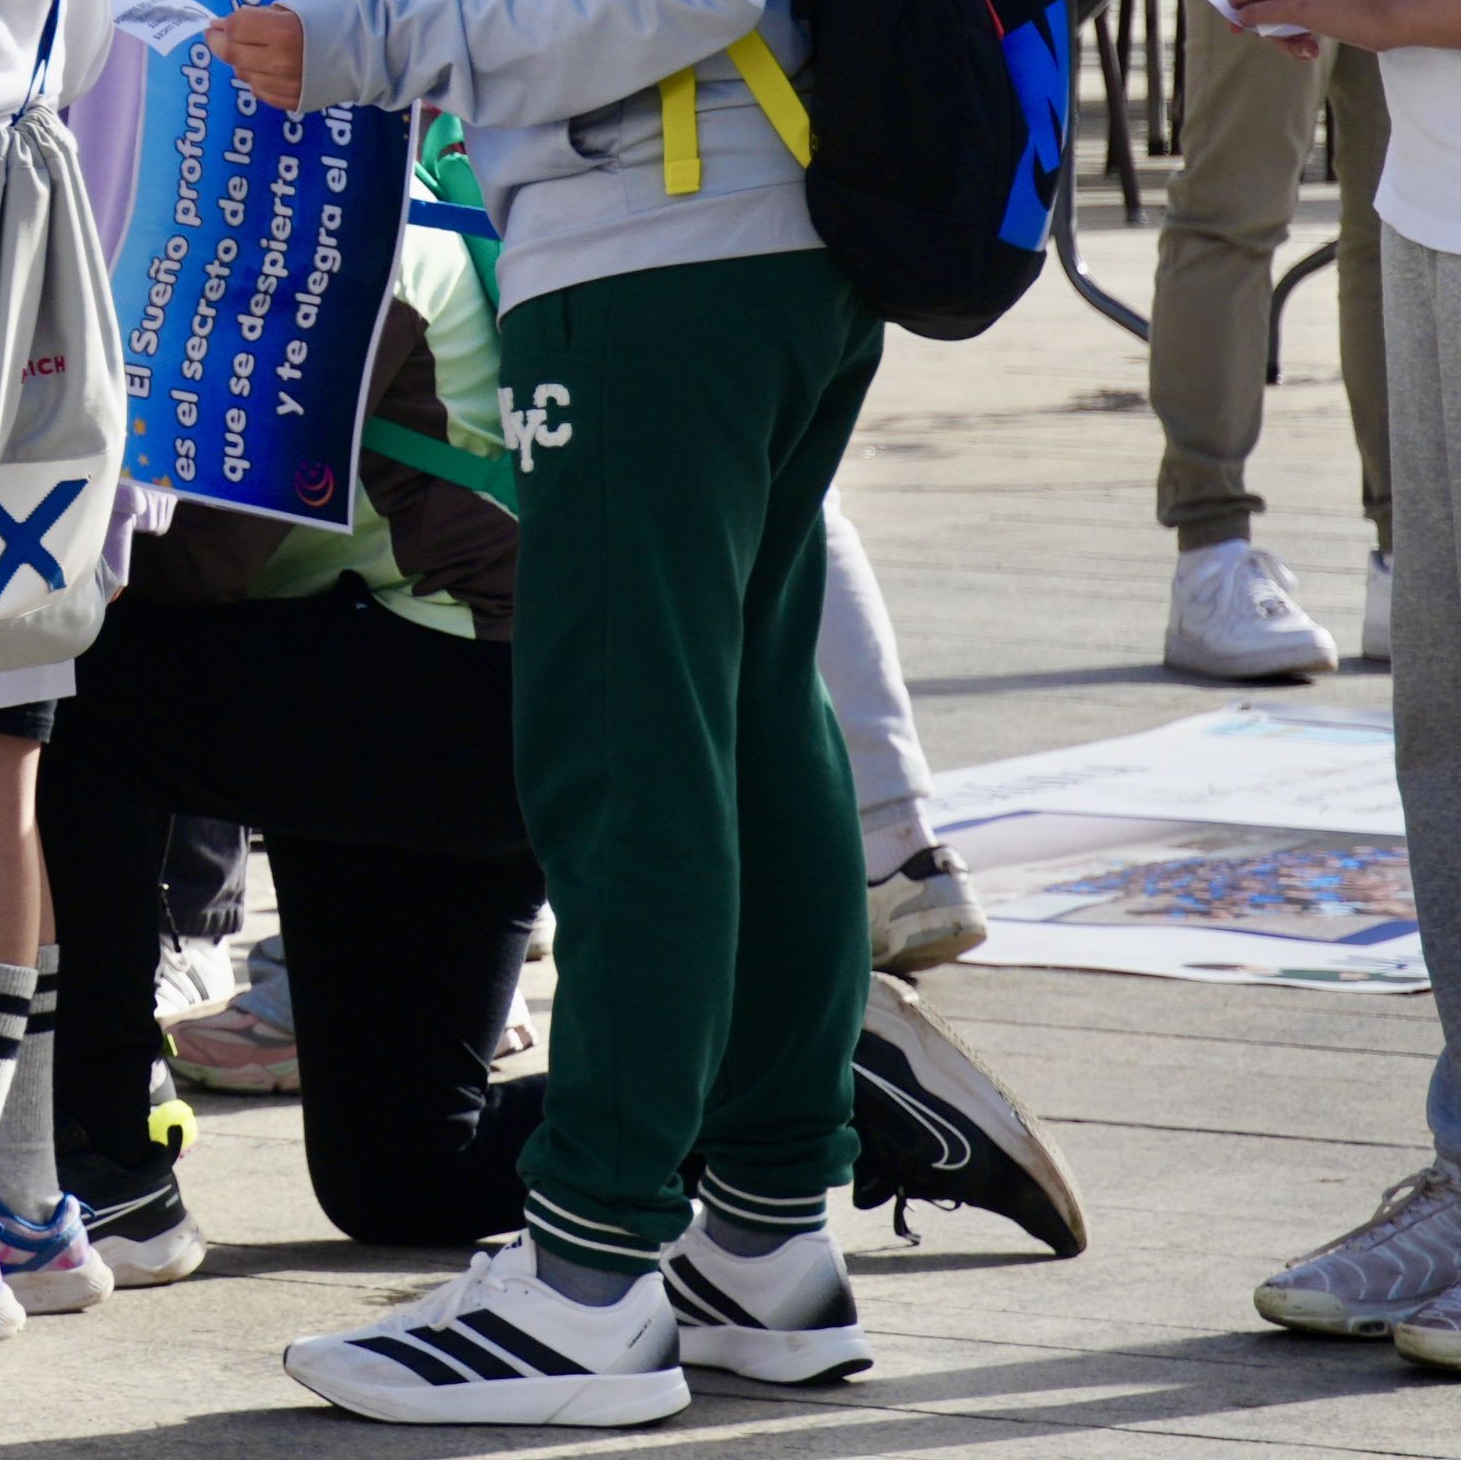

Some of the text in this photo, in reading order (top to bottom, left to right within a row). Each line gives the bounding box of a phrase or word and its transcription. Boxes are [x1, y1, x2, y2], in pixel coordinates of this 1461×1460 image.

[223, 127, 254, 165] la
[320, 155, 349, 194] el
[125, 42, 212, 399] El Sueño profundo
[218, 175, 249, 227] de
[236, 154, 300, 342] despierta
[294, 203, 343, 330] alegra
[181, 237, 239, 381] secreto
[229, 352, 255, 398] se
[275, 339, 308, 381] te
[170, 390, 199, 428] el
[276, 390, 305, 417] y
[175, 438, 197, 482] es
[222, 408, 251, 483] que
